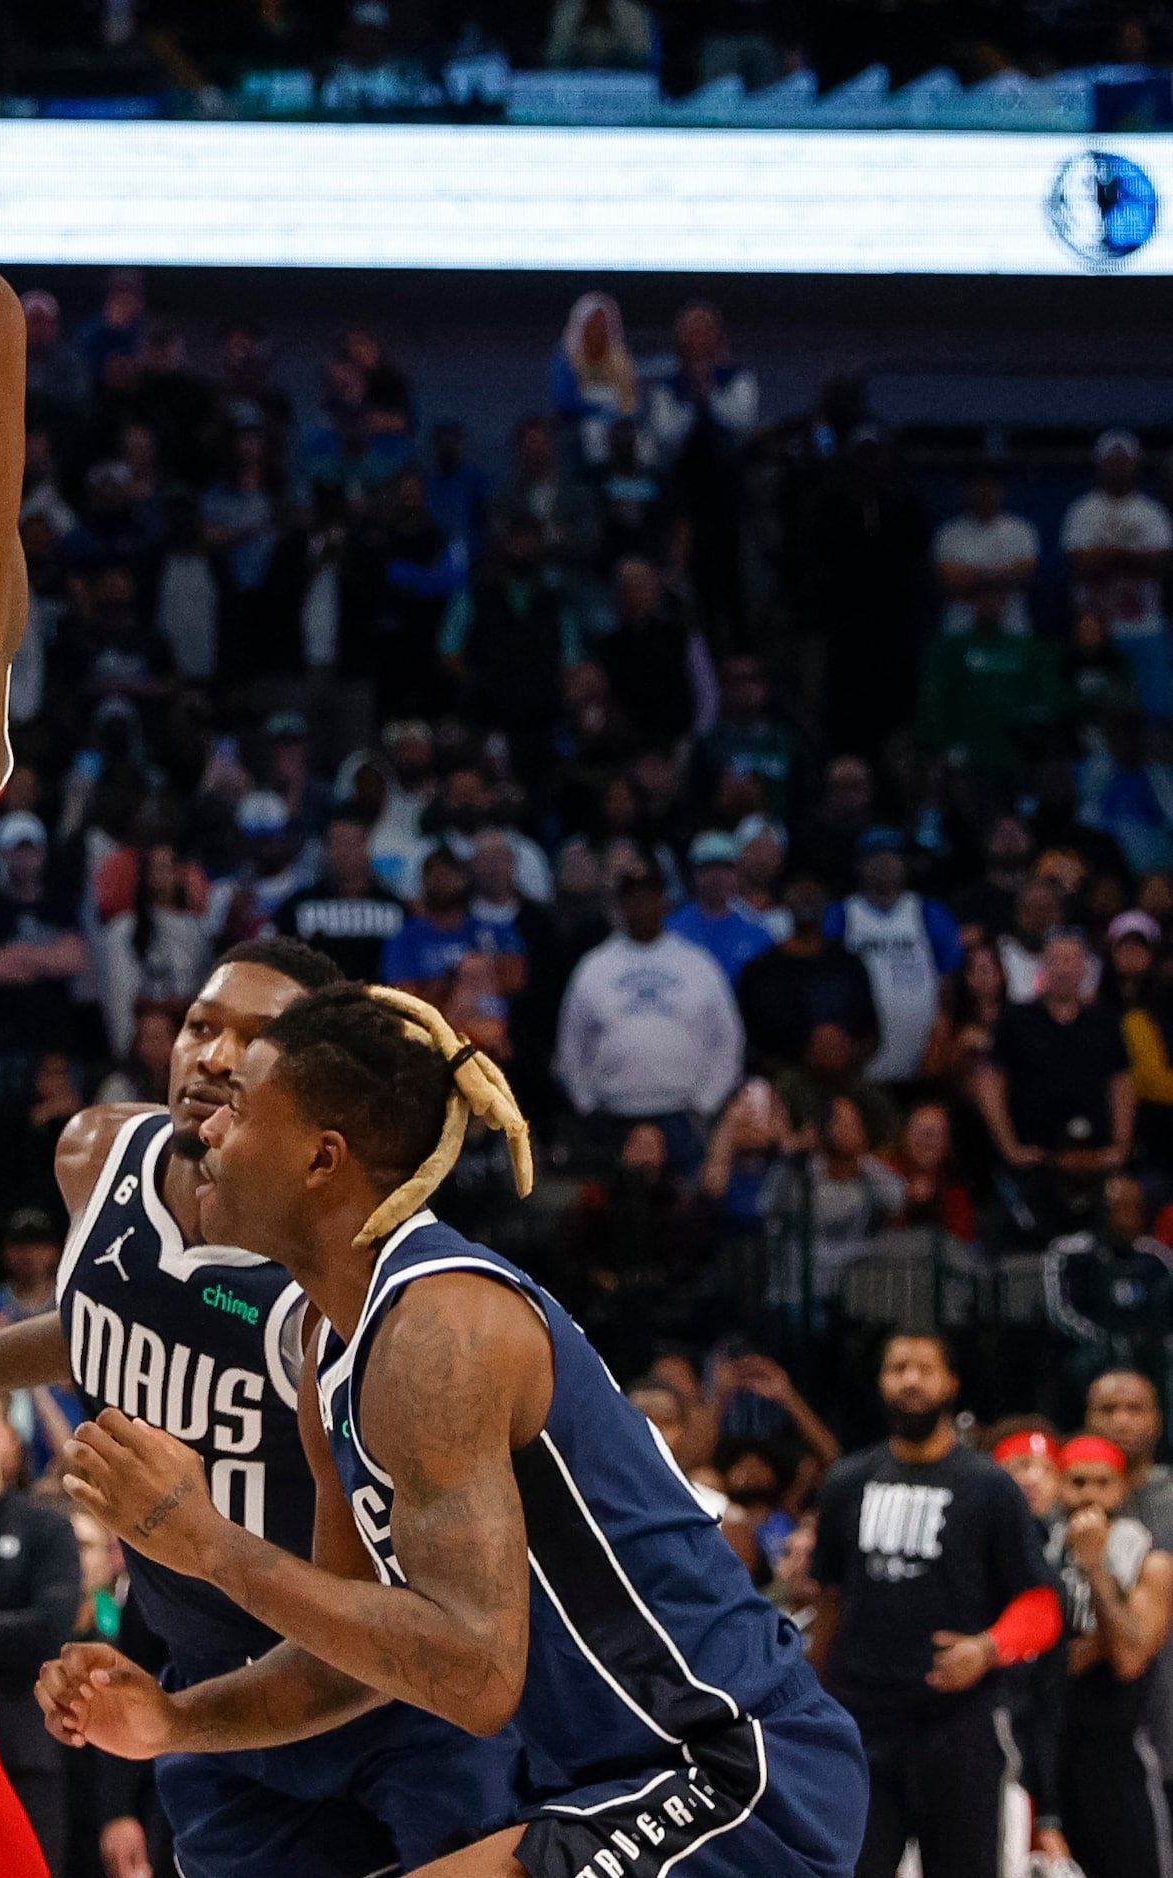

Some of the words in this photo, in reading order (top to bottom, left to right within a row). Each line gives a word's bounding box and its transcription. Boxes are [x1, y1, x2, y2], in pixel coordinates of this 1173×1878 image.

[113, 1174, 139, 1206] 6
[202, 1284, 259, 1325] chime
[858, 1481, 954, 1560] VOTE
